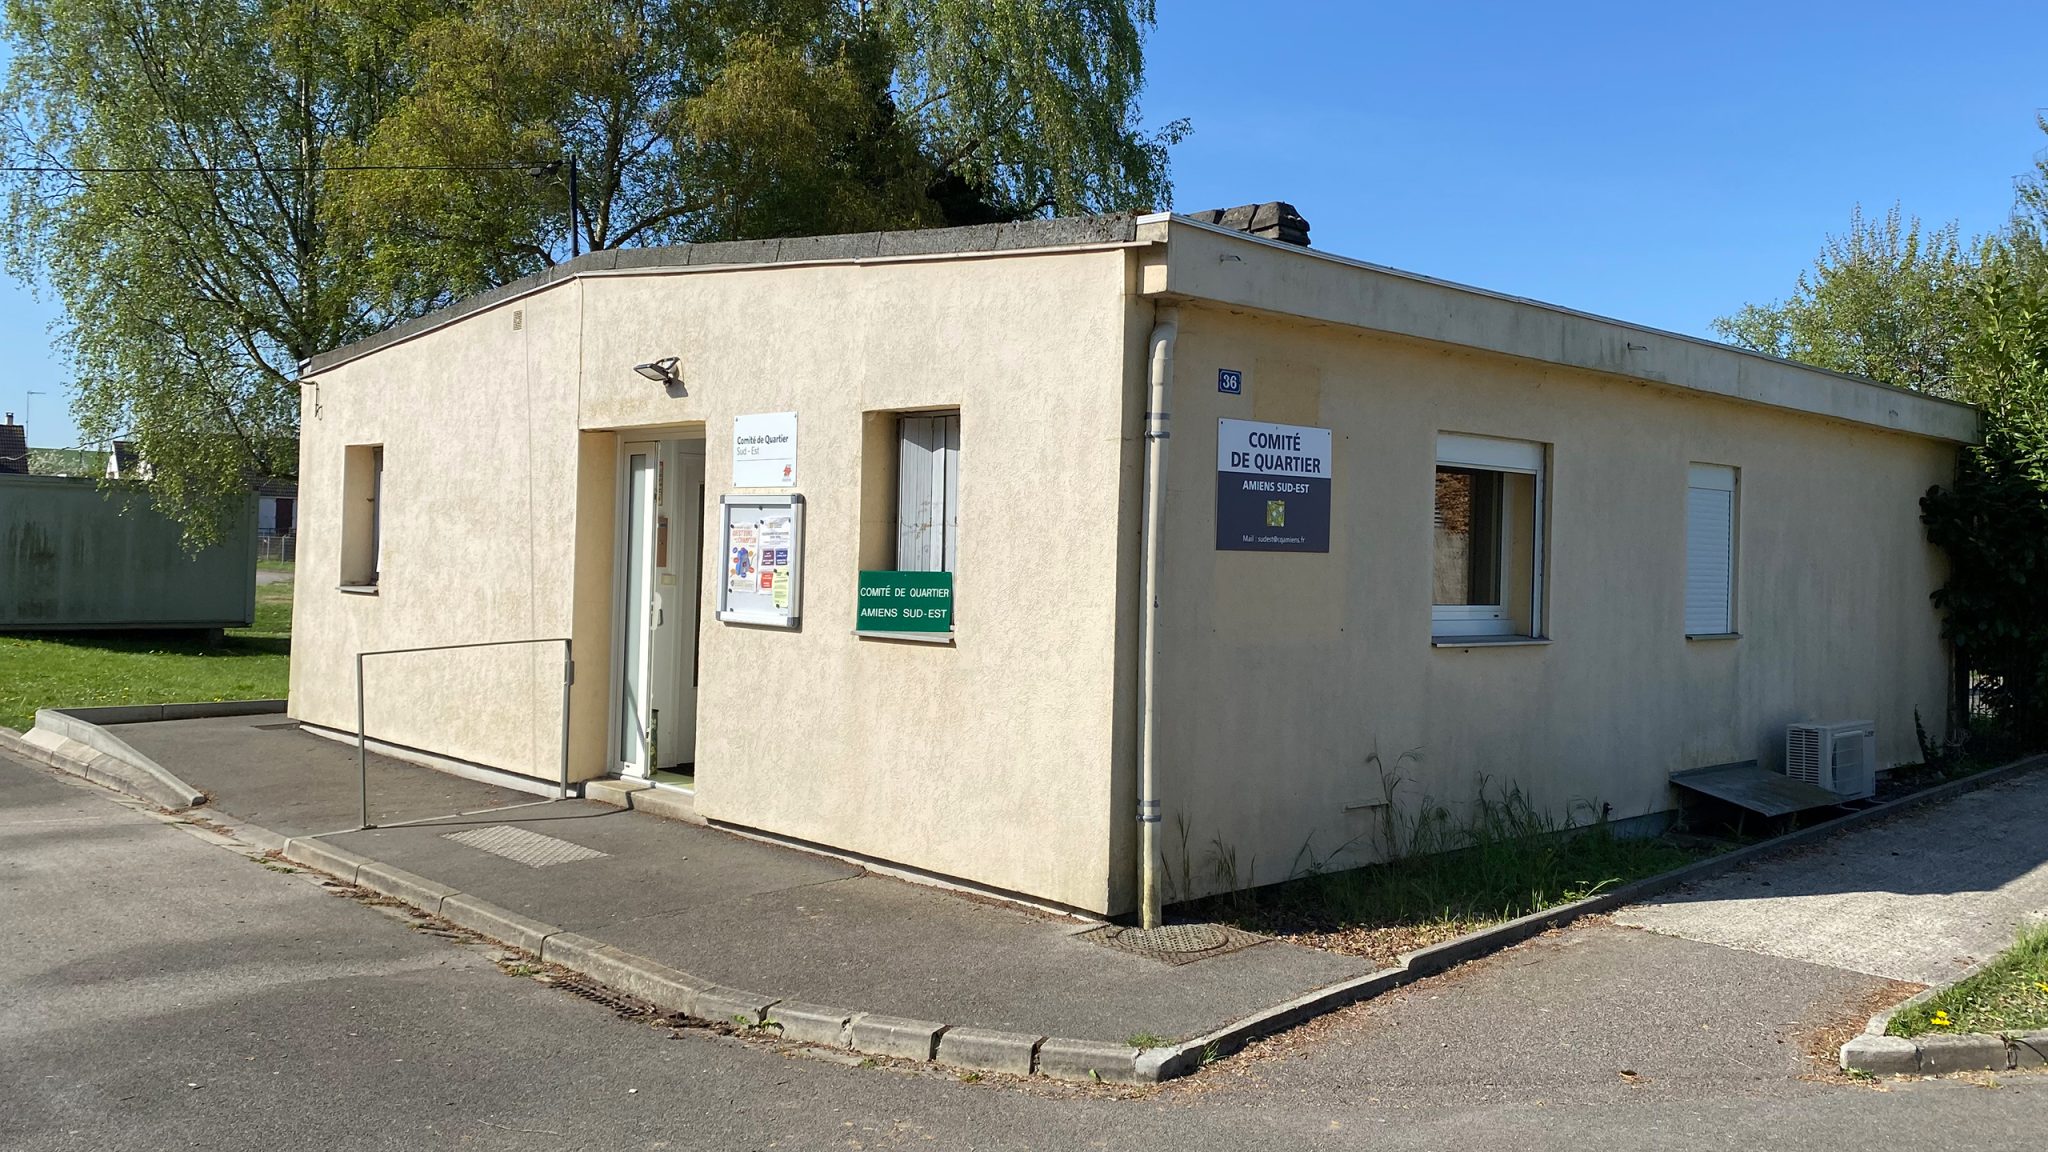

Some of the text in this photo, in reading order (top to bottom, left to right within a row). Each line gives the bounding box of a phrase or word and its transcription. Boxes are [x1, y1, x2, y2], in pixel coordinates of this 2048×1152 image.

[1223, 374, 1237, 390] 36
[737, 434, 788, 445] Comité de Quartier
[1249, 431, 1301, 451] COMITÉ
[737, 446, 747, 456] Sud
[751, 446, 759, 455] Est
[1231, 451, 1321, 474] DE QUARTIER
[1242, 480, 1310, 494] AMIENS SUD-EST
[861, 585, 949, 598] COMITÉ DE QUARTIER
[861, 608, 947, 619] AMIENS SUD-EST
